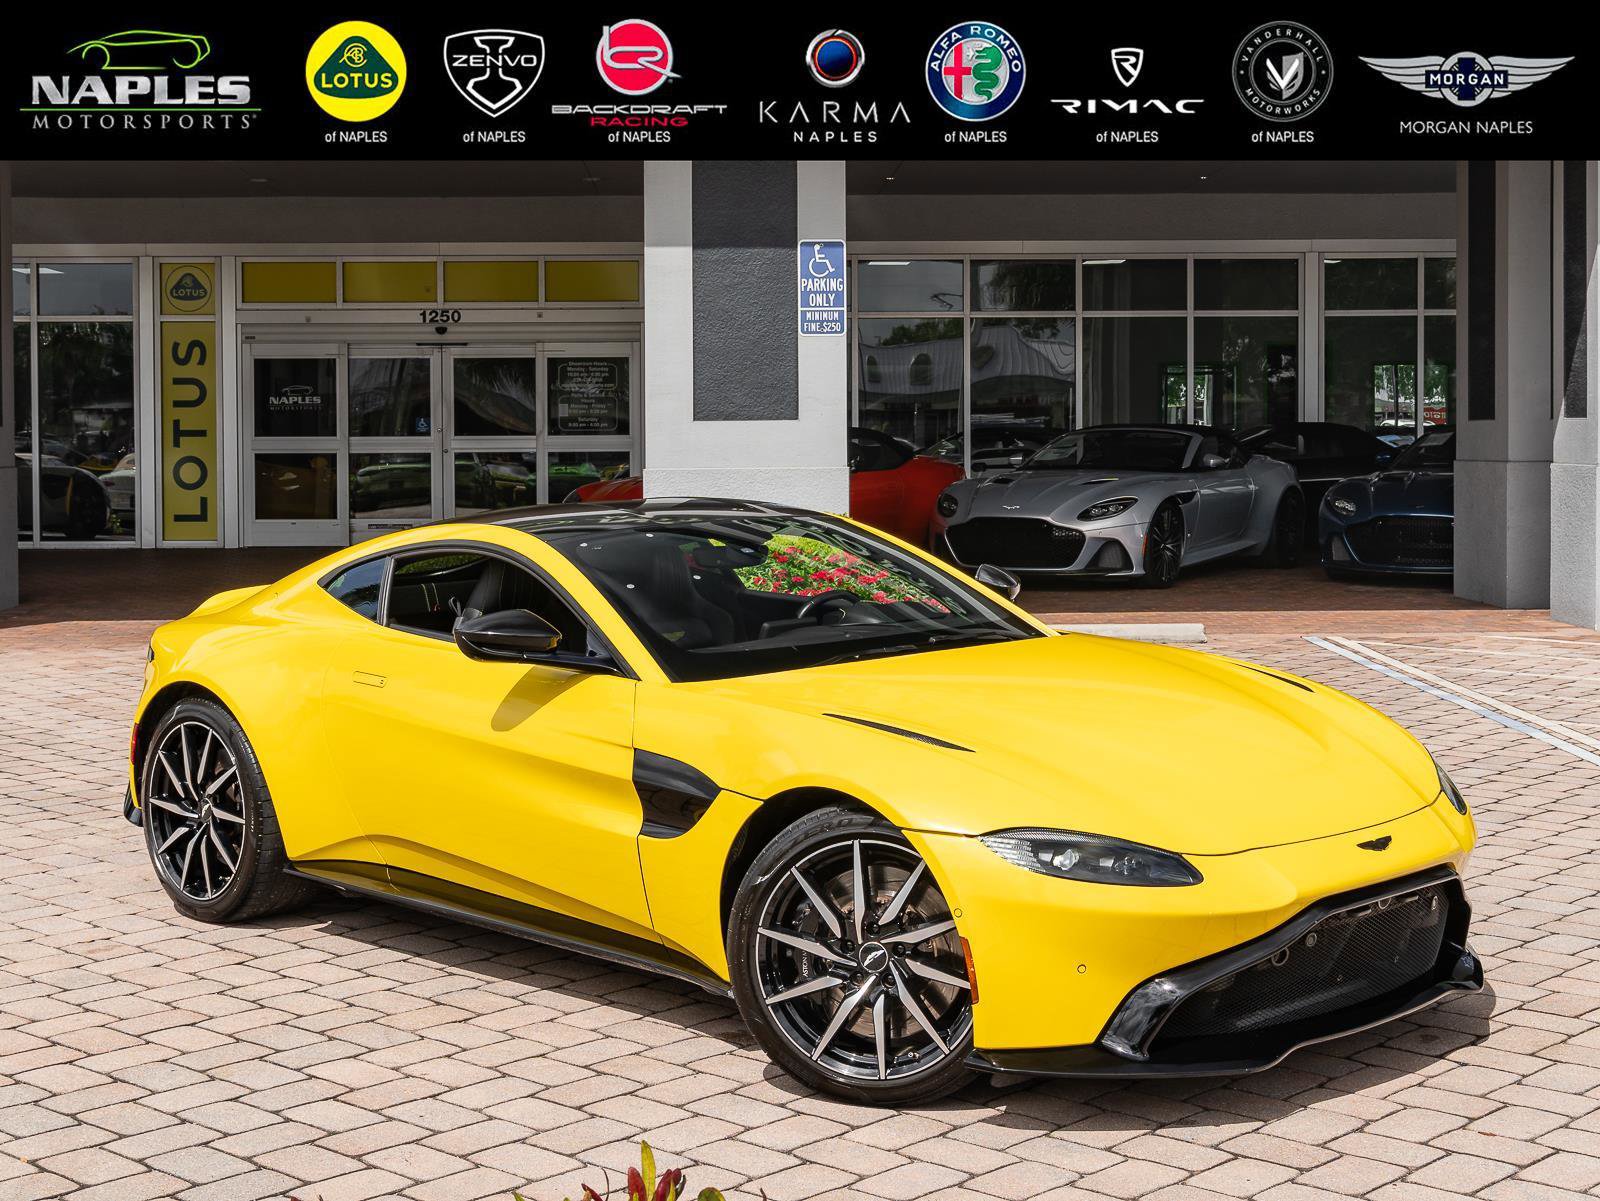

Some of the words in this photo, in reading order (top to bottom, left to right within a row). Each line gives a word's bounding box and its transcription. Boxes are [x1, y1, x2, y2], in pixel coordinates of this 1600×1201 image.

[801, 278, 843, 291] PARKING
[809, 293, 835, 307] ONLY
[419, 310, 462, 323] 1250
[806, 311, 839, 321] MINIMUM
[804, 322, 820, 331] FINE
[823, 322, 841, 332] $250
[269, 396, 321, 404] NAPLES
[171, 339, 208, 522] LOTUS
